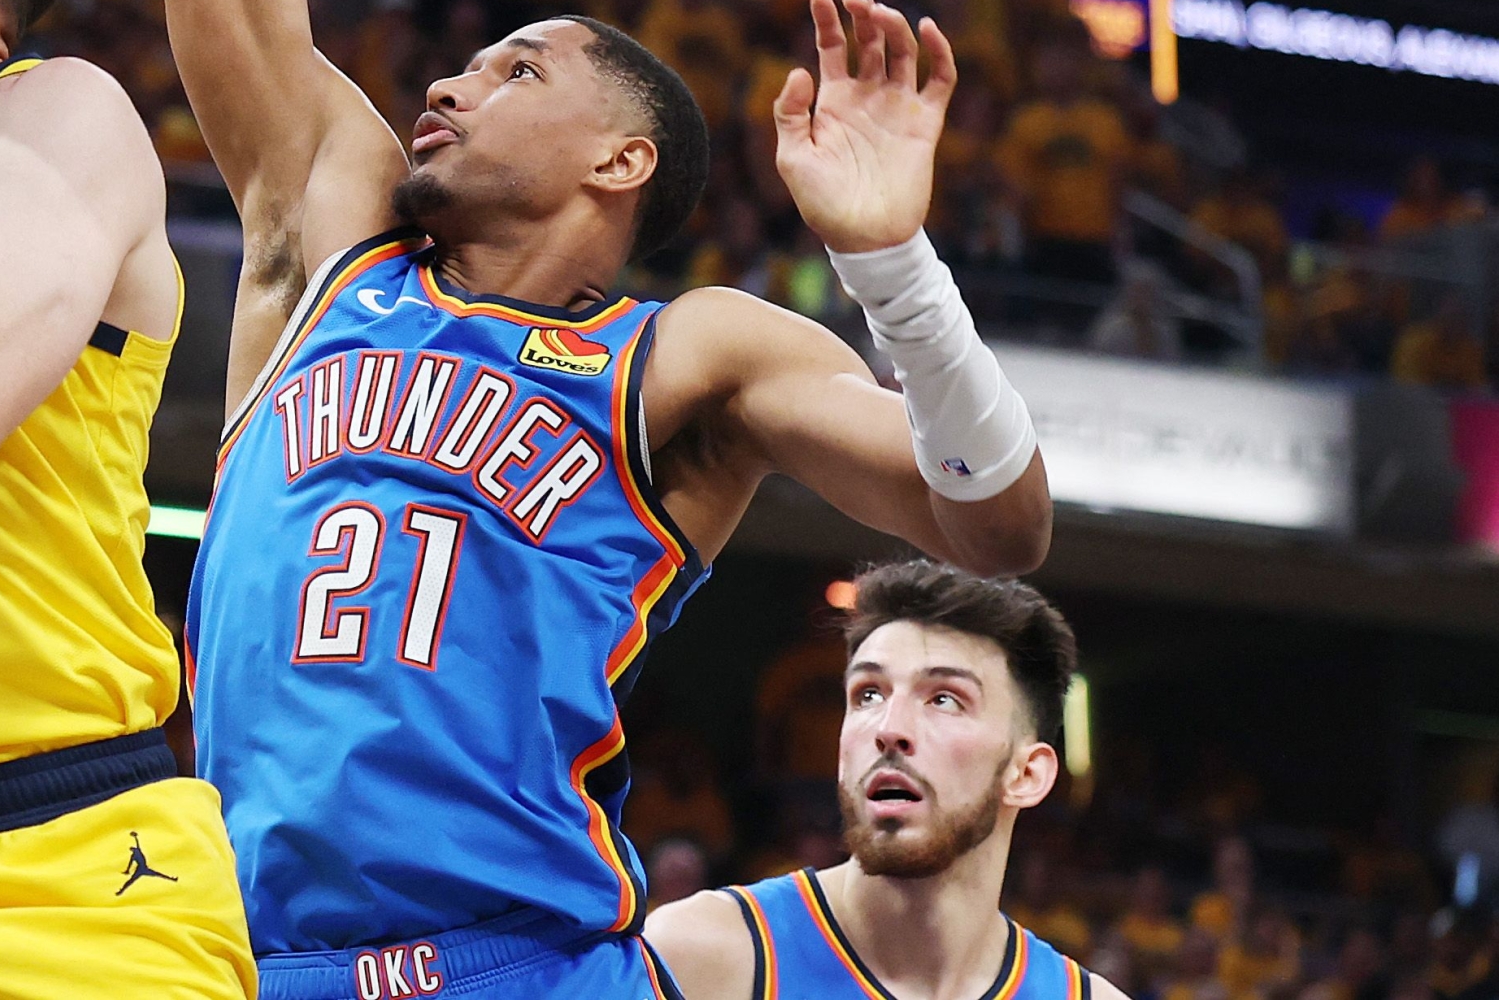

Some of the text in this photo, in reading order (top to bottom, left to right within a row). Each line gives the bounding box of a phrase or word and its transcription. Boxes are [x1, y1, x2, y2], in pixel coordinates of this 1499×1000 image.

[273, 351, 606, 546] THUNDER
[291, 501, 468, 672] 21
[354, 941, 444, 1000] OKC
